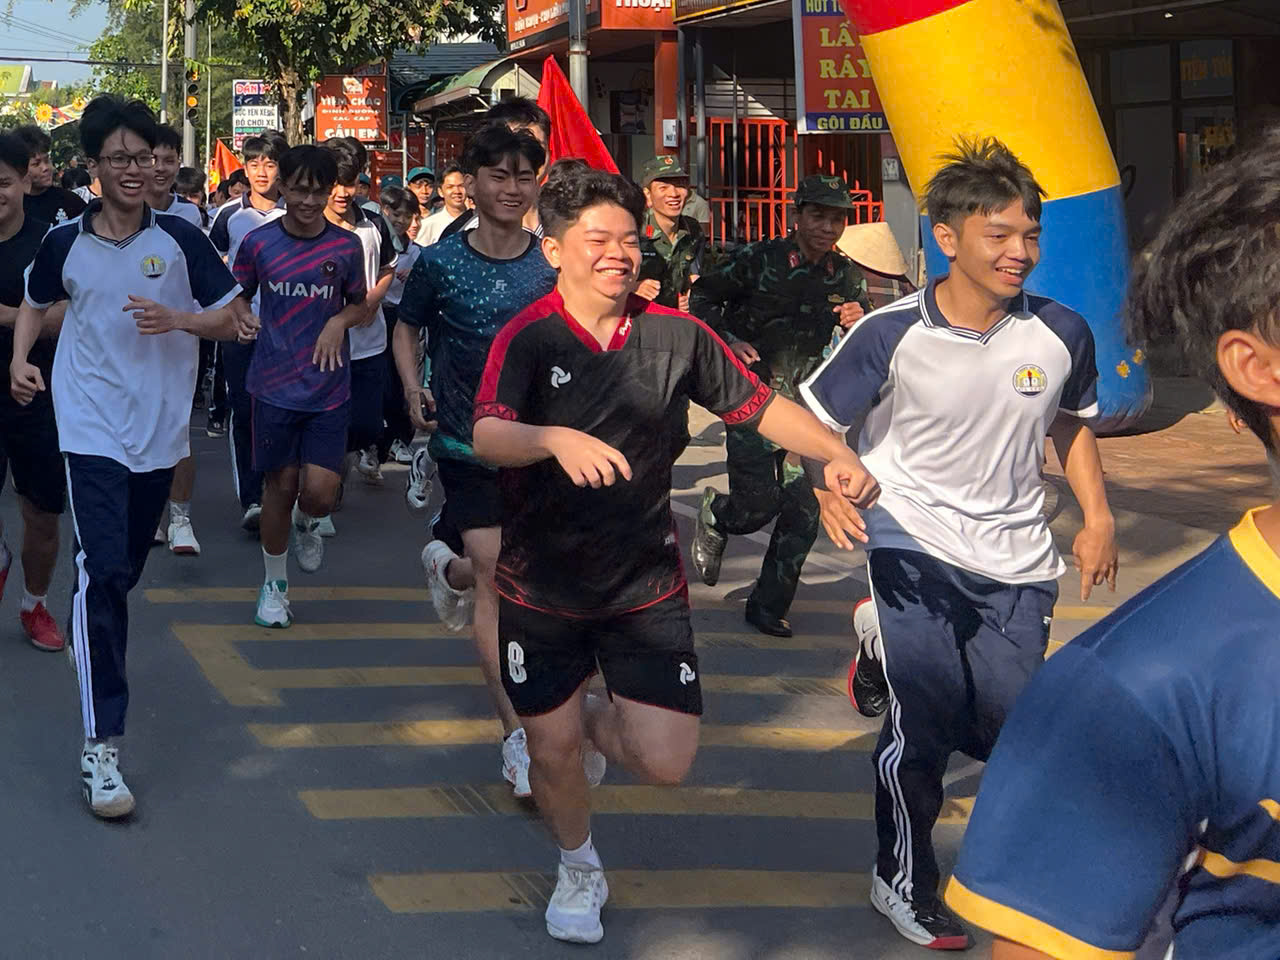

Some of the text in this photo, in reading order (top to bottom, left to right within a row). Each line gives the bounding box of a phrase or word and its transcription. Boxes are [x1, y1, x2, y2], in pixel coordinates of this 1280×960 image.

[819, 20, 866, 47] LẤ
[819, 53, 873, 79] RÁY
[823, 89, 871, 109] TAI
[268, 280, 334, 300] MIAMI
